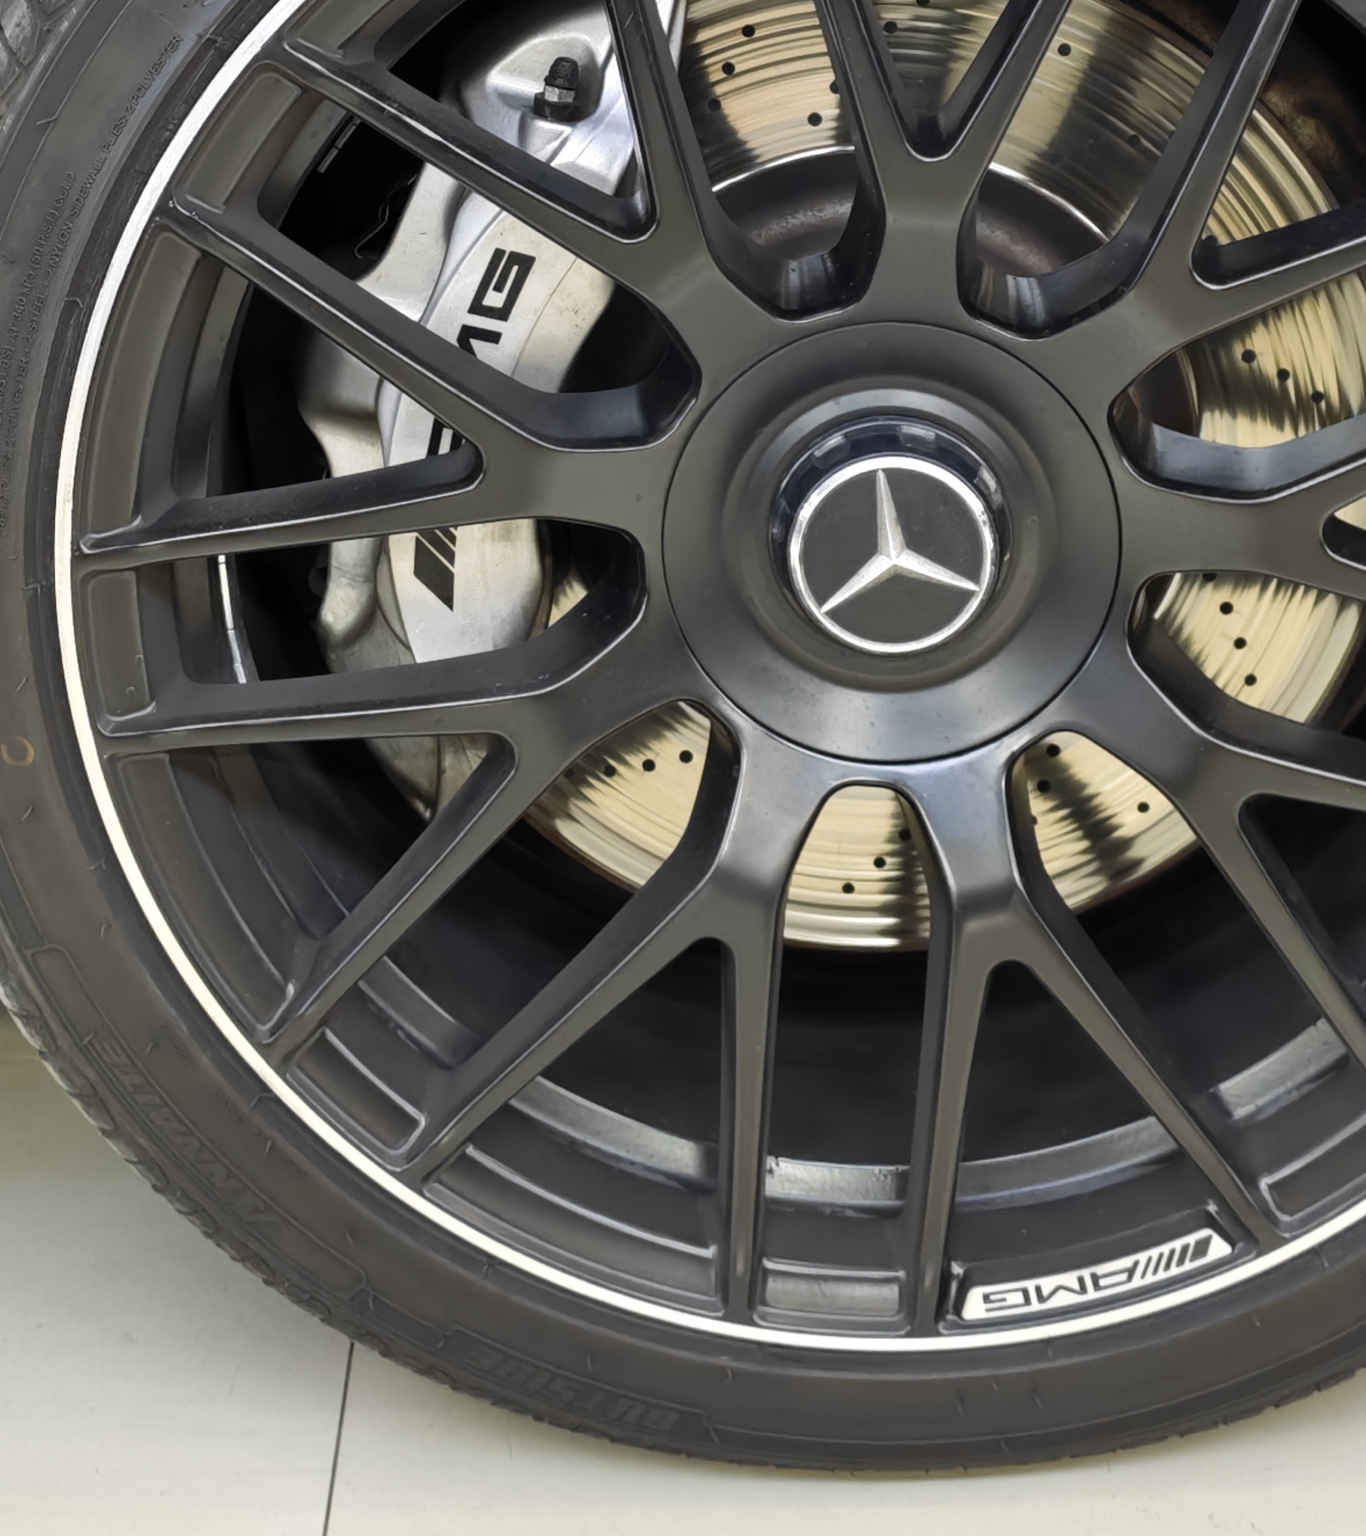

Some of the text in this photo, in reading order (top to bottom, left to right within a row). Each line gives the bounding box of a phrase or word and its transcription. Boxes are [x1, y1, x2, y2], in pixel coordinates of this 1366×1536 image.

[24, 289, 48, 333] STEEL
[45, 218, 75, 268] NYLON
[65, 151, 108, 219] SIDEWALL
[125, 32, 185, 107] POLYESTER
[49, 168, 78, 209] COLD
[981, 1260, 1140, 1313] AMG
[462, 1339, 681, 1434] OUTSIDE
